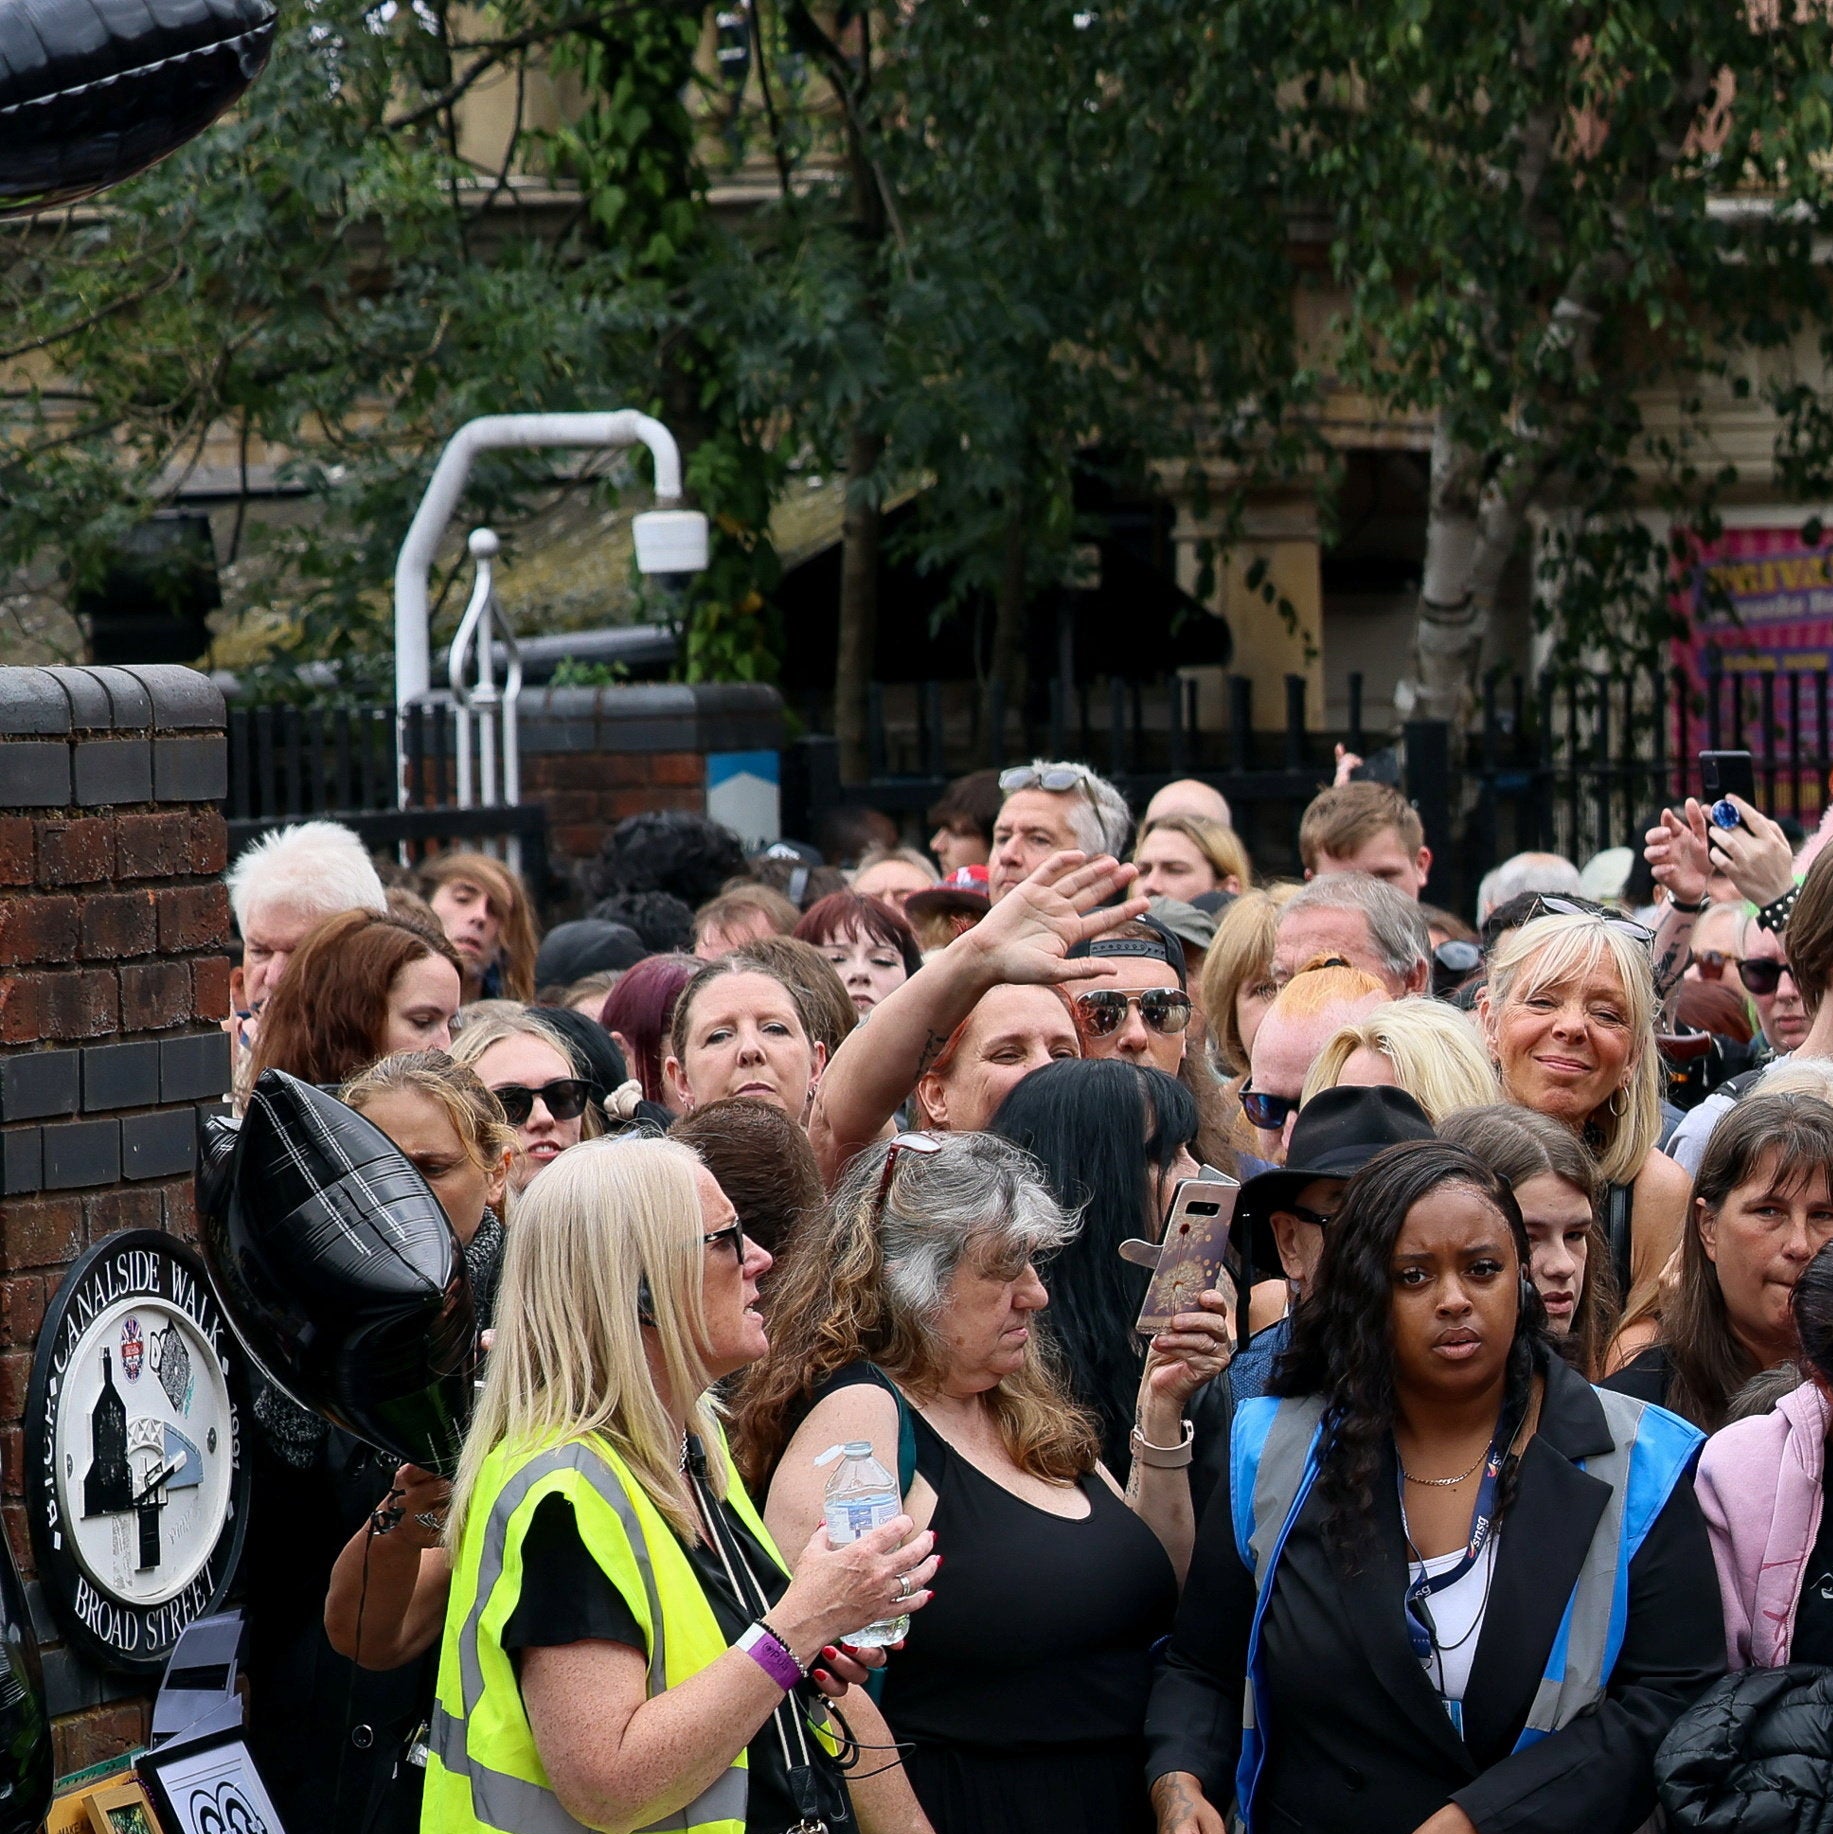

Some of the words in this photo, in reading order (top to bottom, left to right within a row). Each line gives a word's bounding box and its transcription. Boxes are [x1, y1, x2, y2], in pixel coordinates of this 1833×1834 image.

[53, 1250, 161, 1374] CANALSIDE
[169, 1258, 226, 1351] WALK
[1471, 1515, 1489, 1549] snsg
[74, 1574, 140, 1652] BROAD
[145, 1557, 216, 1652] STREET
